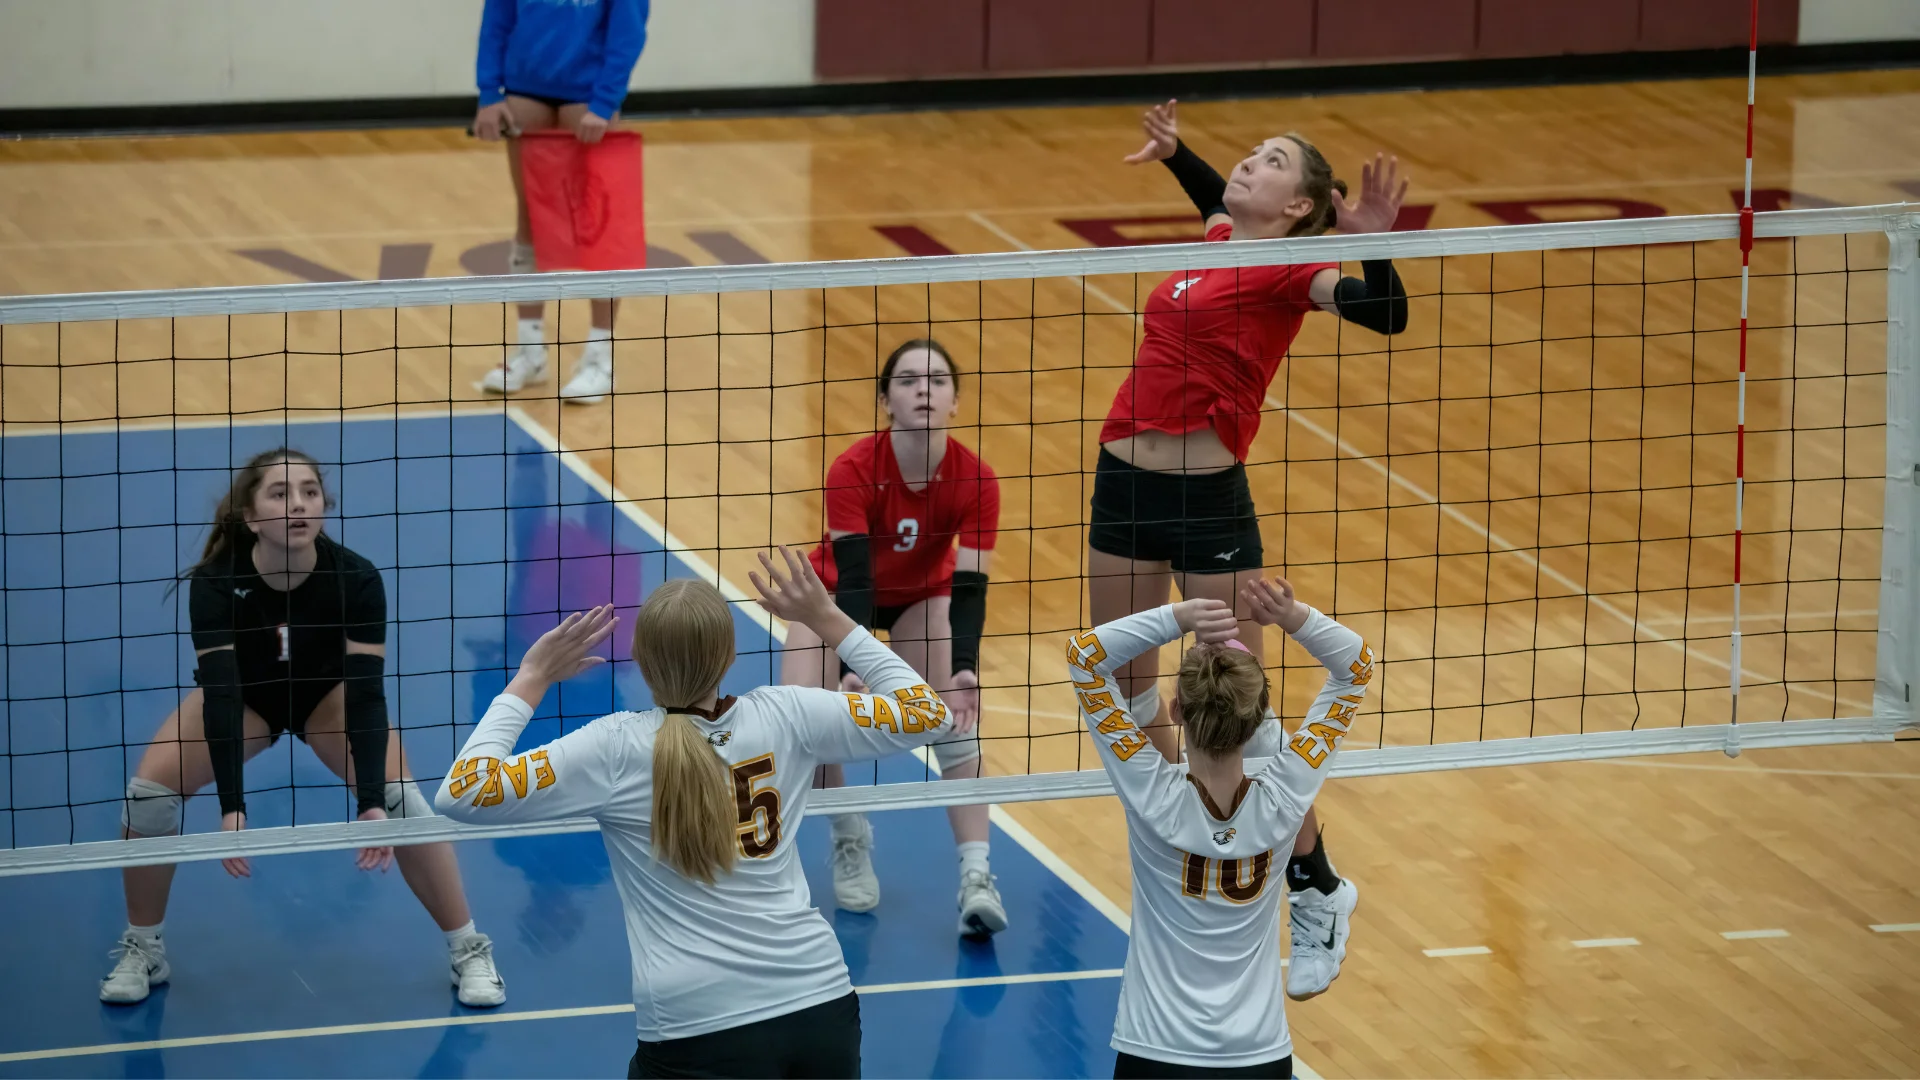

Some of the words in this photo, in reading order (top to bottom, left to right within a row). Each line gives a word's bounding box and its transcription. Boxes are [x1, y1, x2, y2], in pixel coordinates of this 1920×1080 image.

[893, 518, 919, 553] 3
[276, 622, 291, 661] 1
[728, 751, 783, 859] 5
[1173, 847, 1273, 905] 10
